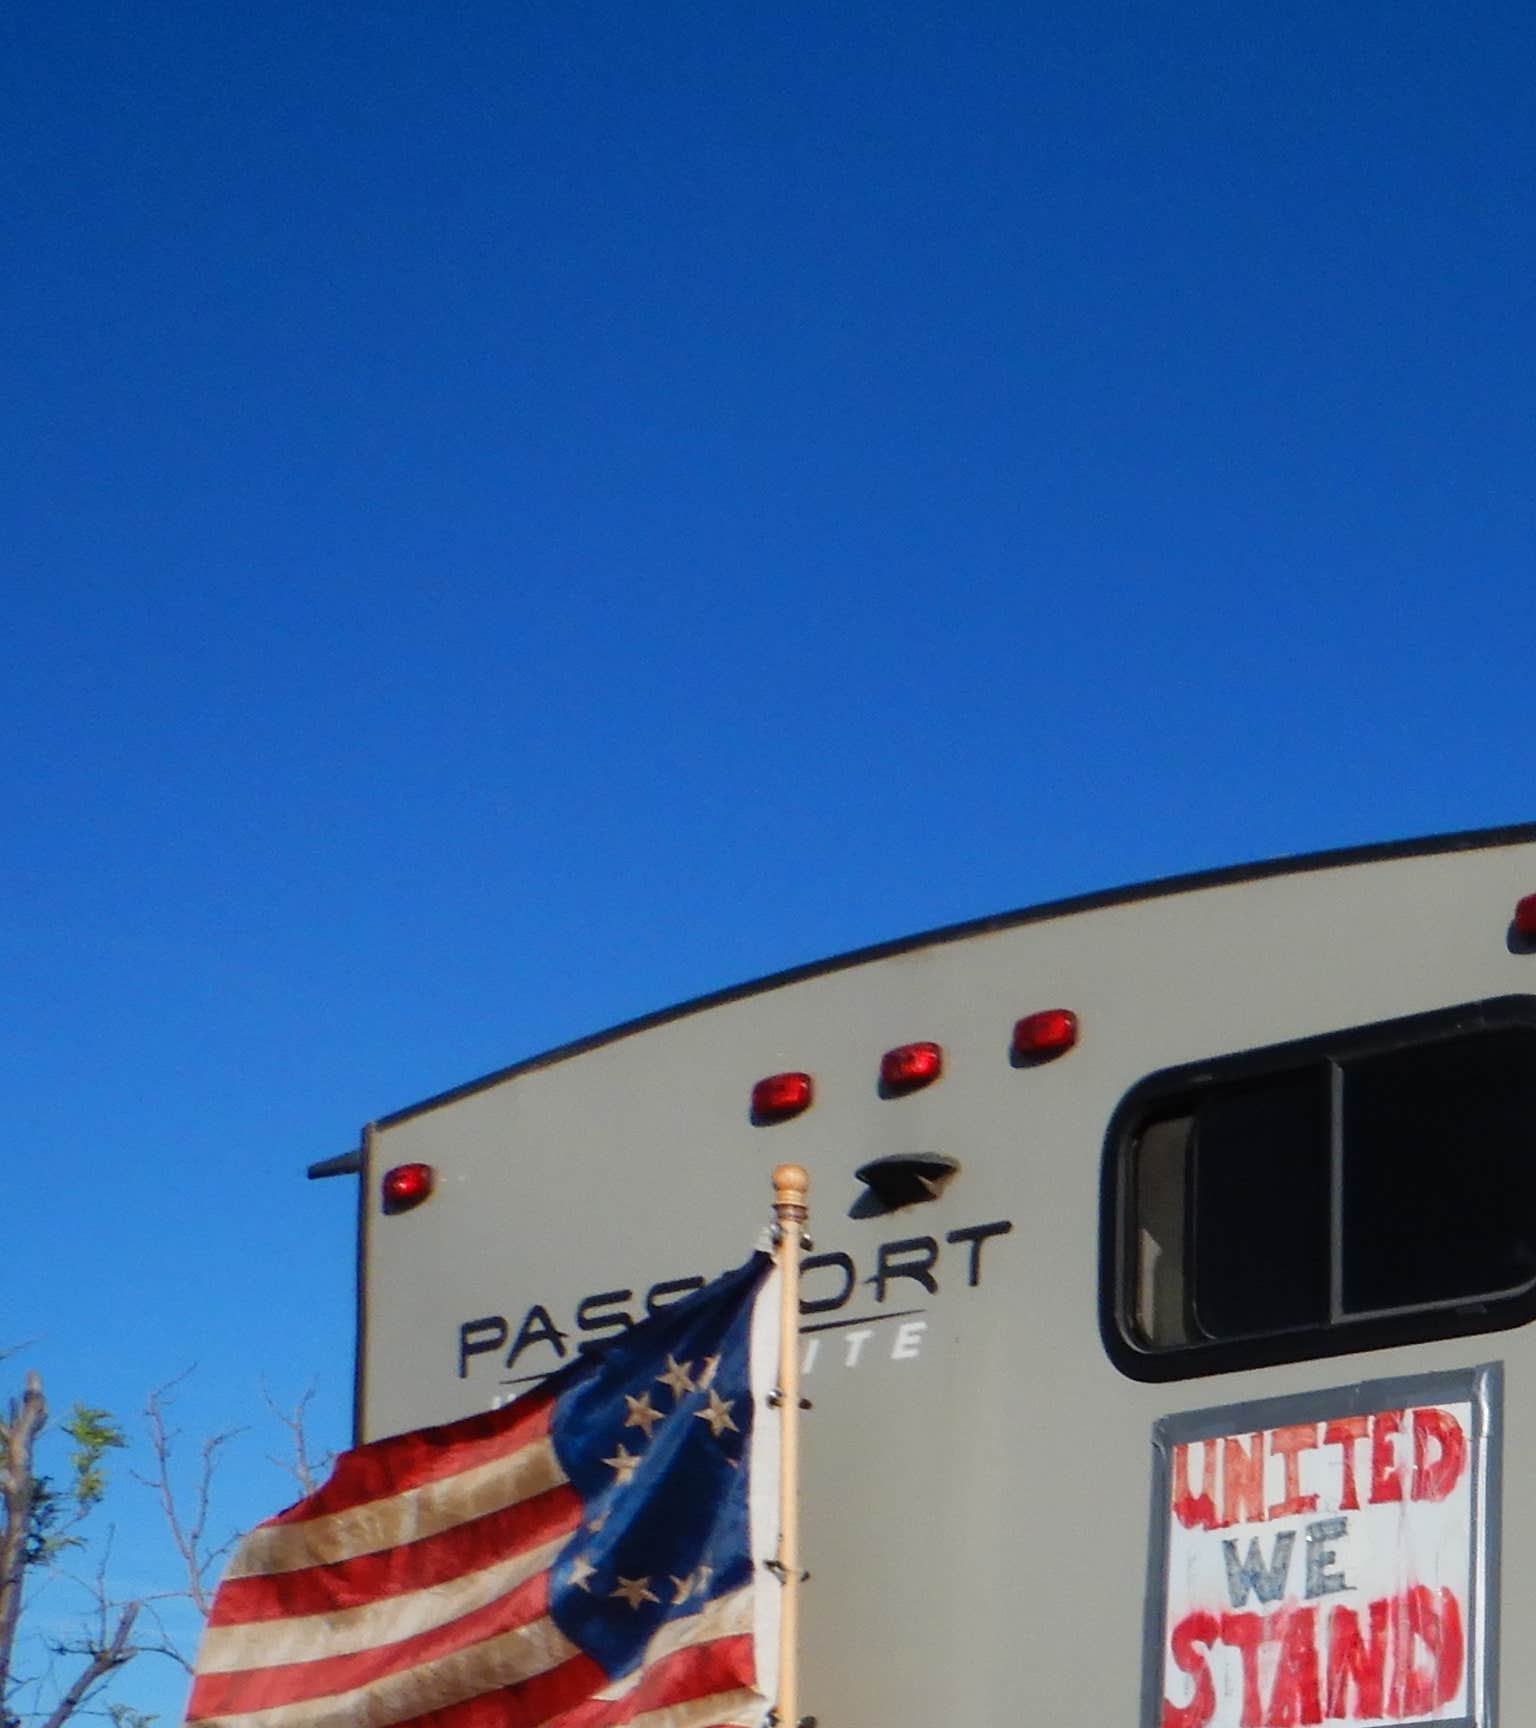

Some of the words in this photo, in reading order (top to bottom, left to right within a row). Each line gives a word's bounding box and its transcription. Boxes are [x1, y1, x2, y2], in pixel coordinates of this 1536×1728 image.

[458, 1220, 1013, 1380] PASORT
[1172, 1407, 1470, 1531] UNITED
[1222, 1516, 1358, 1608] WE
